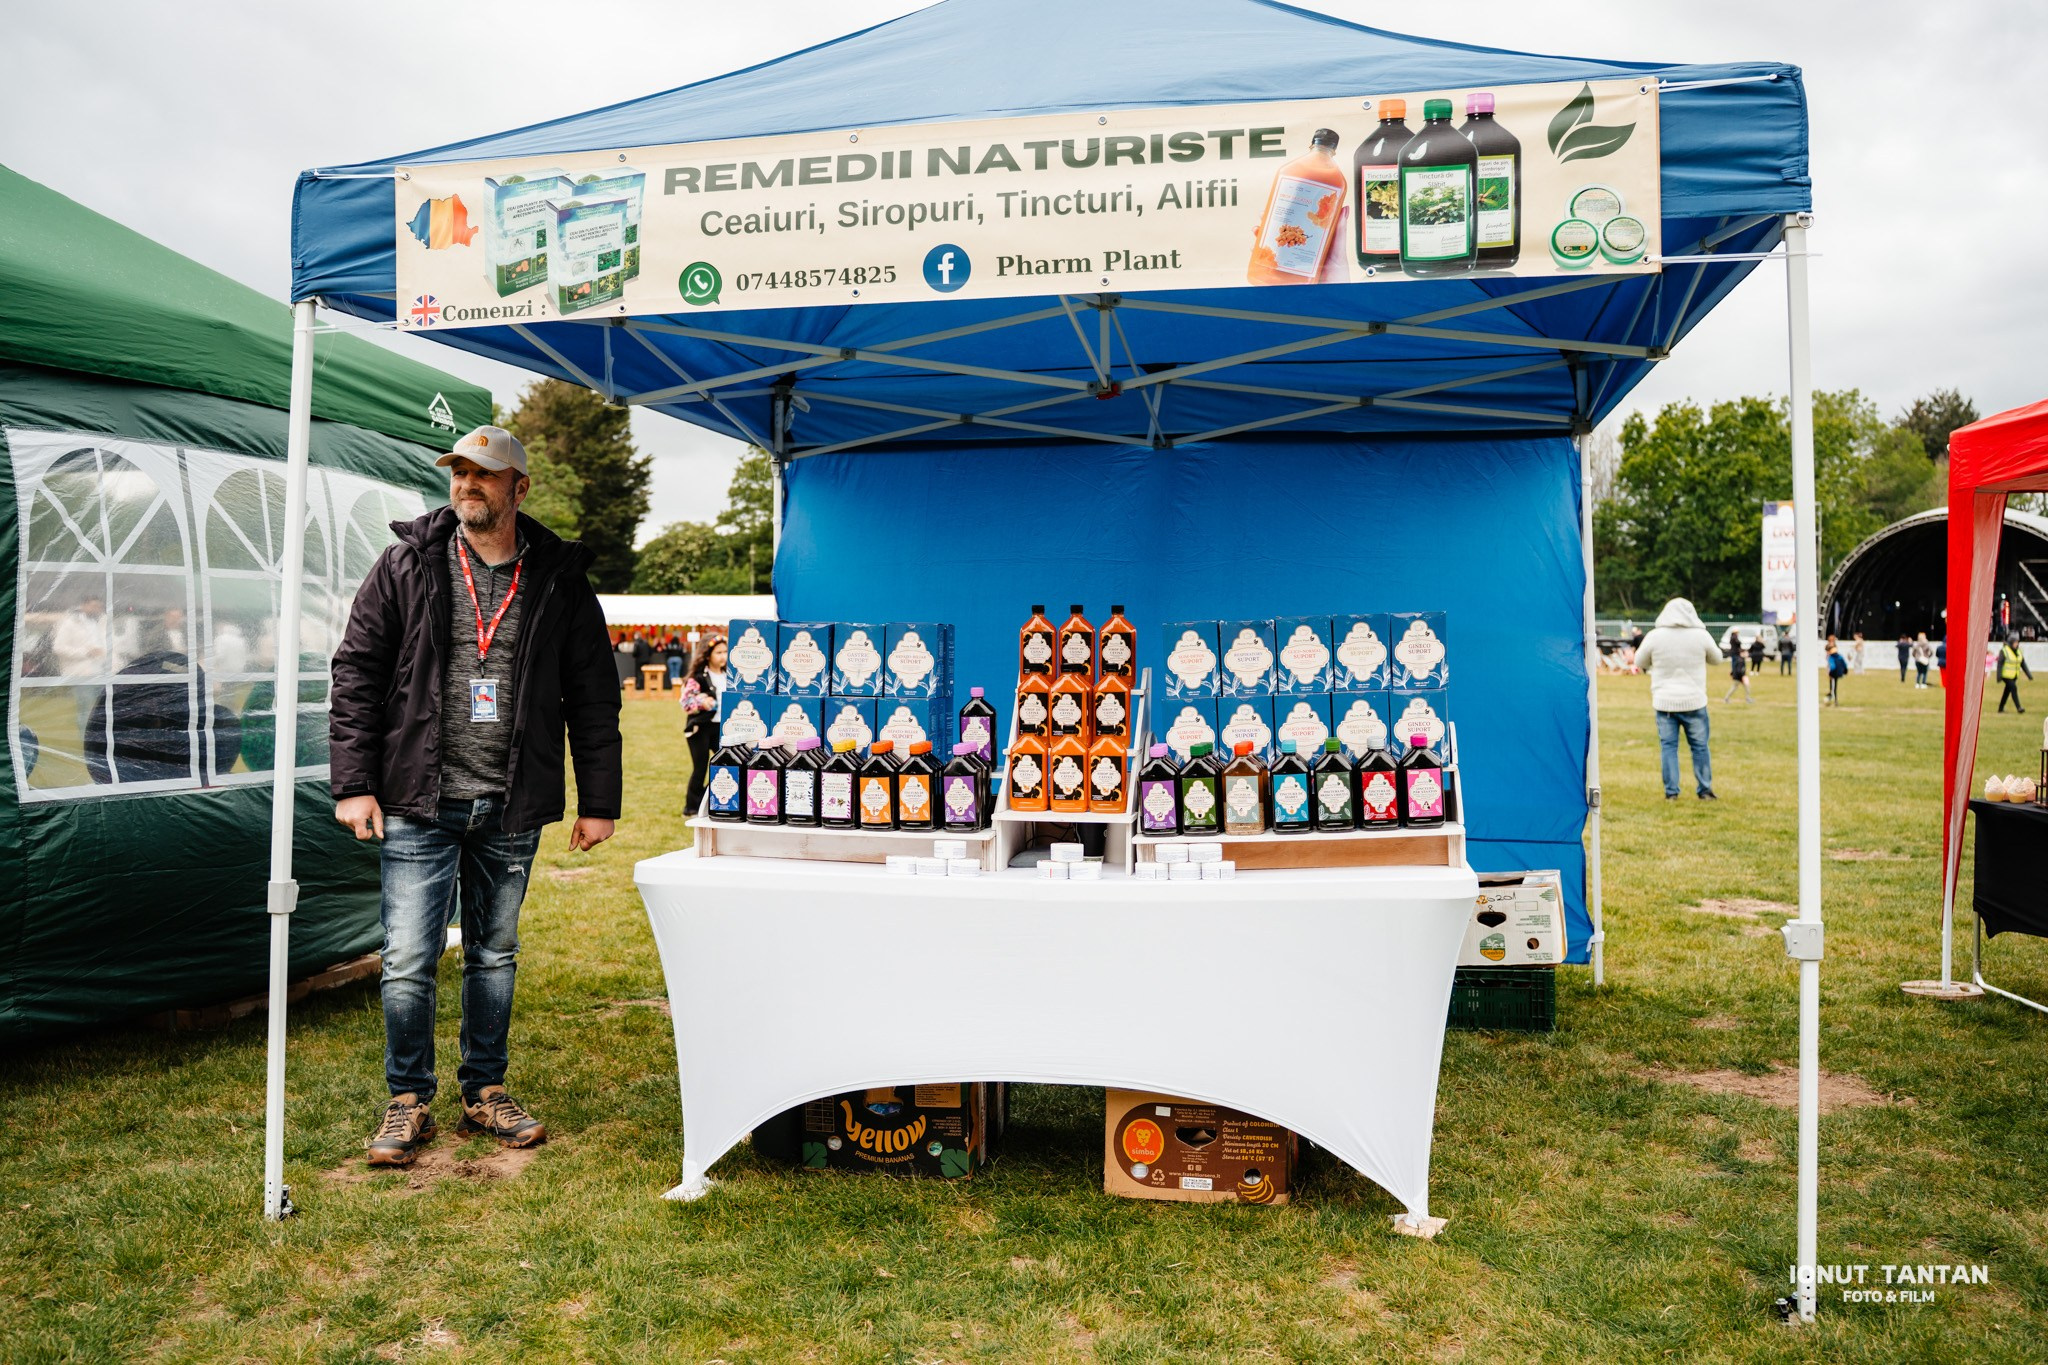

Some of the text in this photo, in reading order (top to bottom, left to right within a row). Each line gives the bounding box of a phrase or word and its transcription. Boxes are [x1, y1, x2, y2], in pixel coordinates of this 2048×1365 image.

[663, 126, 1287, 196] REMEDII NATURISTE
[700, 178, 1239, 237] Ceaiuri, Siropuri, Tincturi, Alifii
[736, 264, 897, 291] 07448574825
[997, 253, 1092, 277] Pharm
[1103, 248, 1182, 272] Plant
[442, 299, 533, 322] Comenzi
[854, 1150, 915, 1164] PREMIUM BANANAS
[1131, 1147, 1155, 1157] simba
